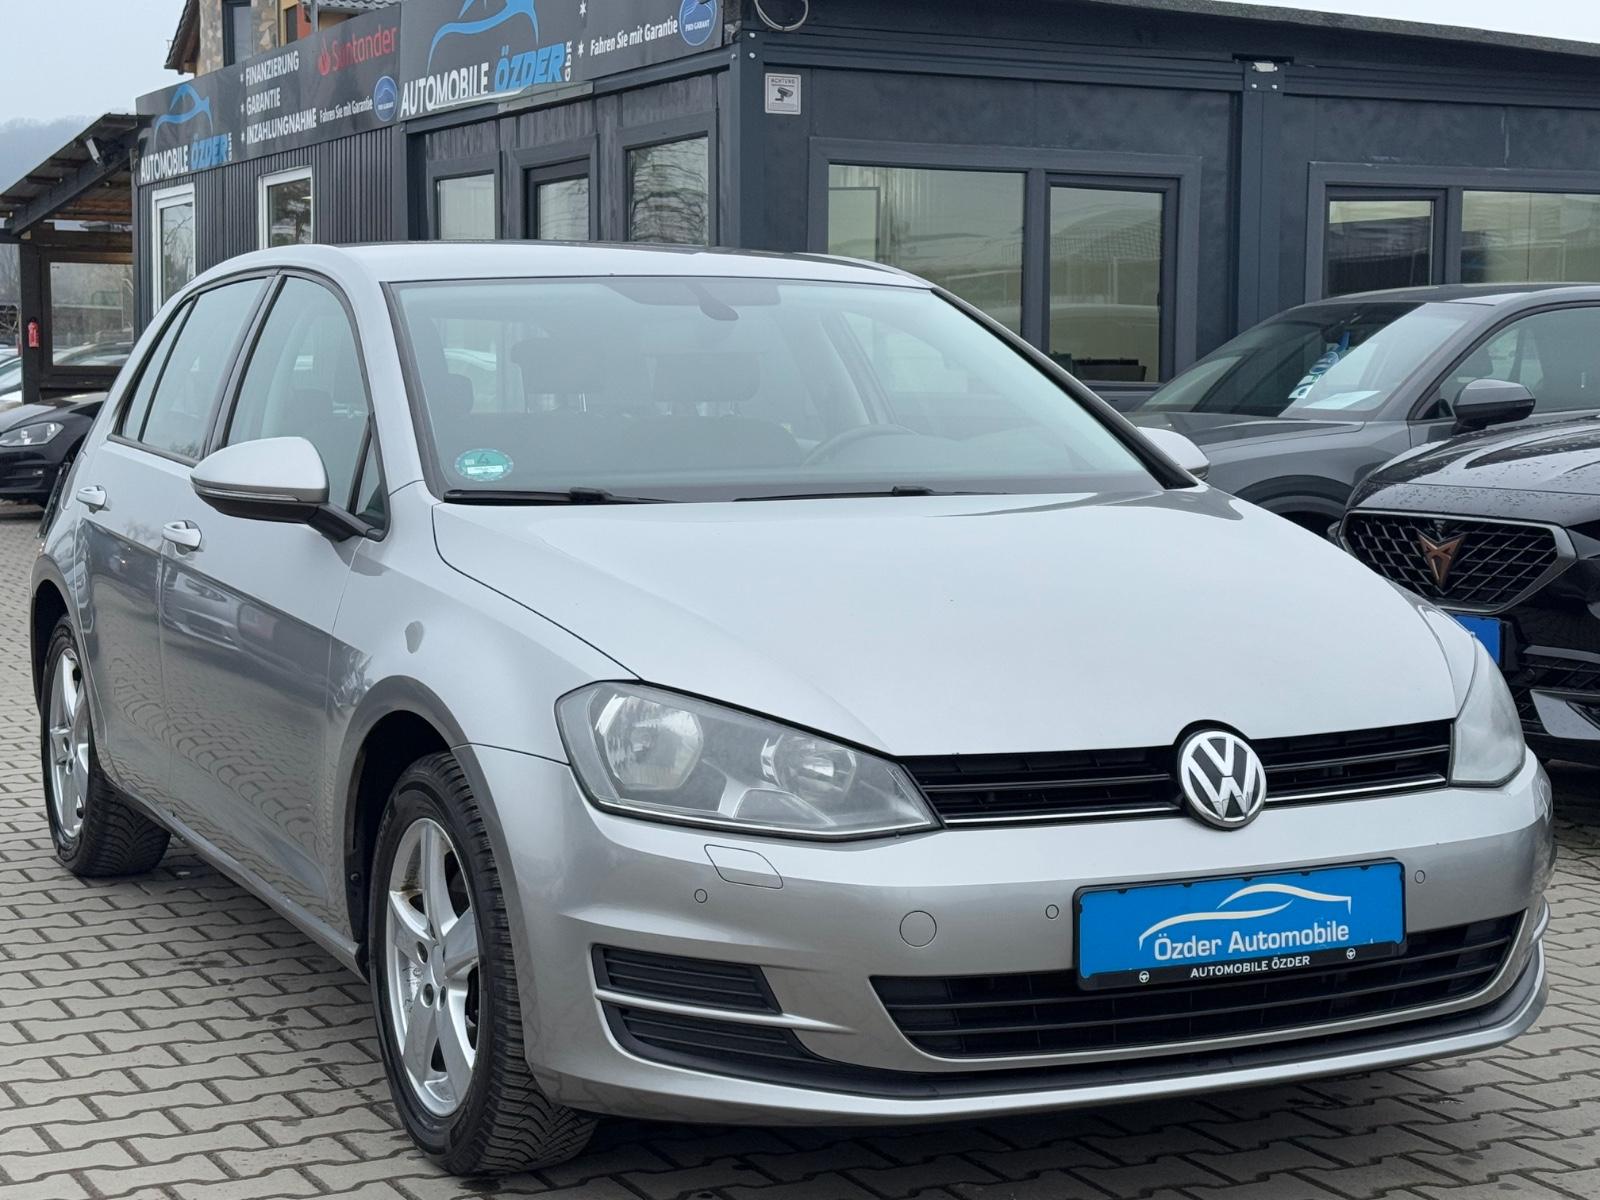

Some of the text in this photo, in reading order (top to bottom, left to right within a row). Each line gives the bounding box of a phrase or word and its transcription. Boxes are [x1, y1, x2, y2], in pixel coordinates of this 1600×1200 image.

[590, 16, 678, 57] Fahren Sie mit Garantie
[245, 50, 300, 87] FINANZIERUNG
[400, 40, 573, 119] AUTOMOBILE ÖZDER GbR
[246, 87, 281, 116] GARANTIE
[246, 107, 317, 145] INZAHLUNGNAHME
[140, 144, 189, 184] AUTOMOBILE
[190, 132, 229, 171] ÖZDER
[1154, 919, 1350, 961] Özder Automobile
[1190, 955, 1311, 978] AUTOMOBILE ÖZDER
